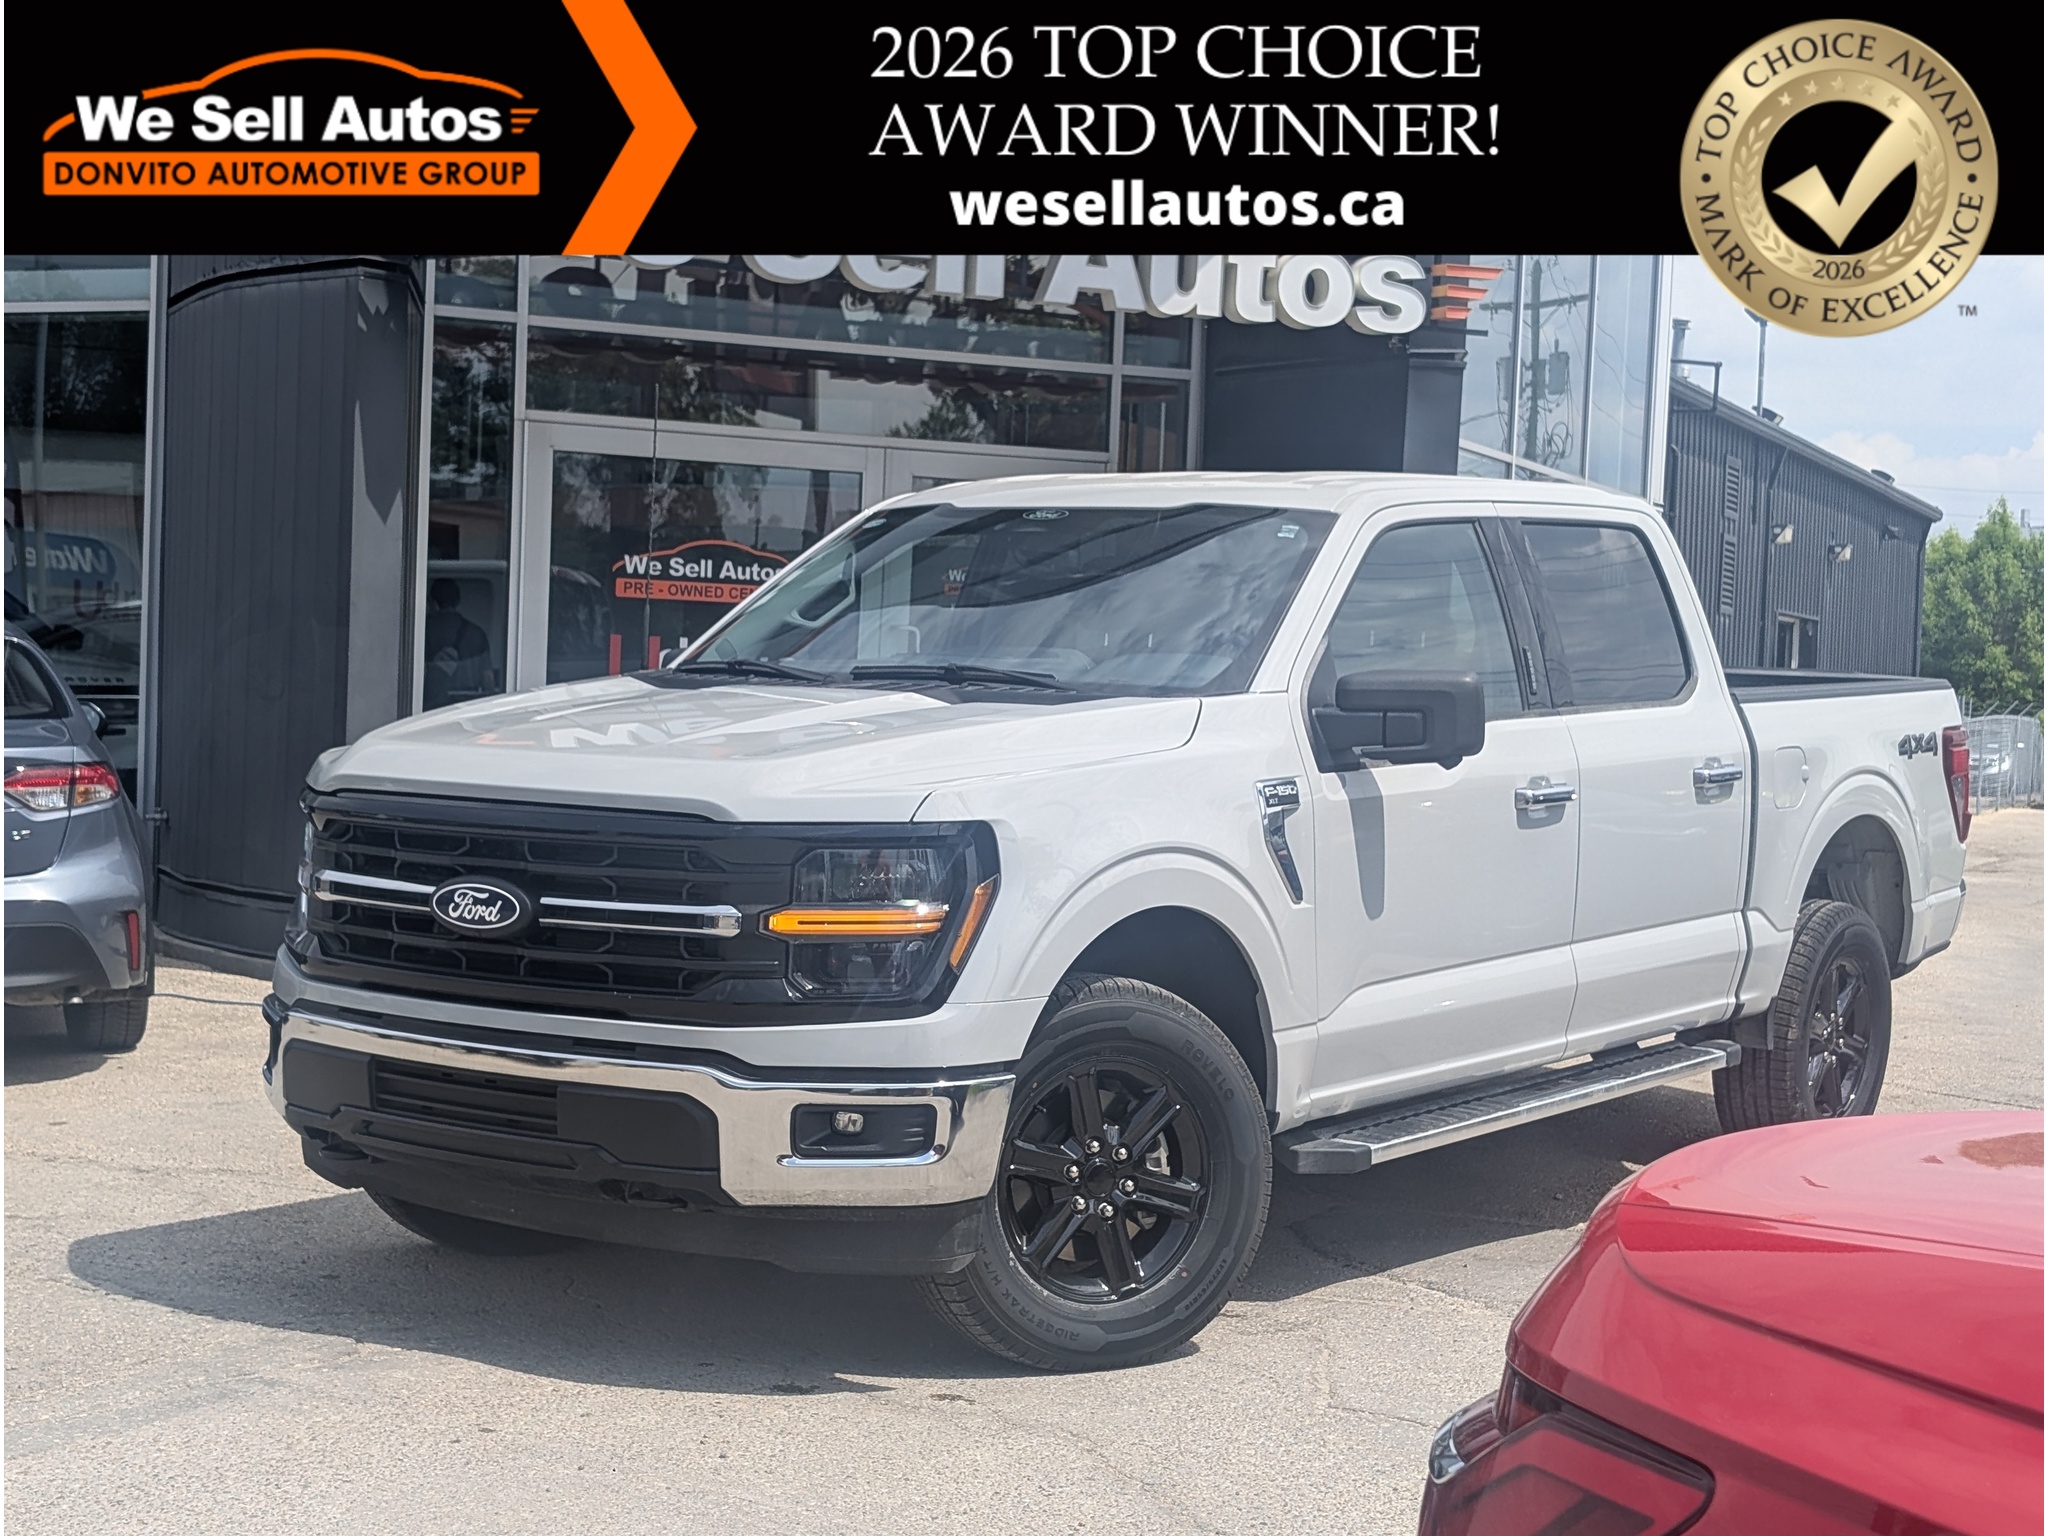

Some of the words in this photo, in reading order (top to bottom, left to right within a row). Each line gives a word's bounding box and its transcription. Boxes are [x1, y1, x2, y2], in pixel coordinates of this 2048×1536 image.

[1034, 255, 1427, 334] Autos
[624, 554, 662, 576] We
[669, 556, 713, 579] Sell
[624, 581, 653, 595] PRE
[668, 584, 724, 598] OWNED
[1264, 784, 1298, 797] F-150
[448, 888, 503, 922] Ford
